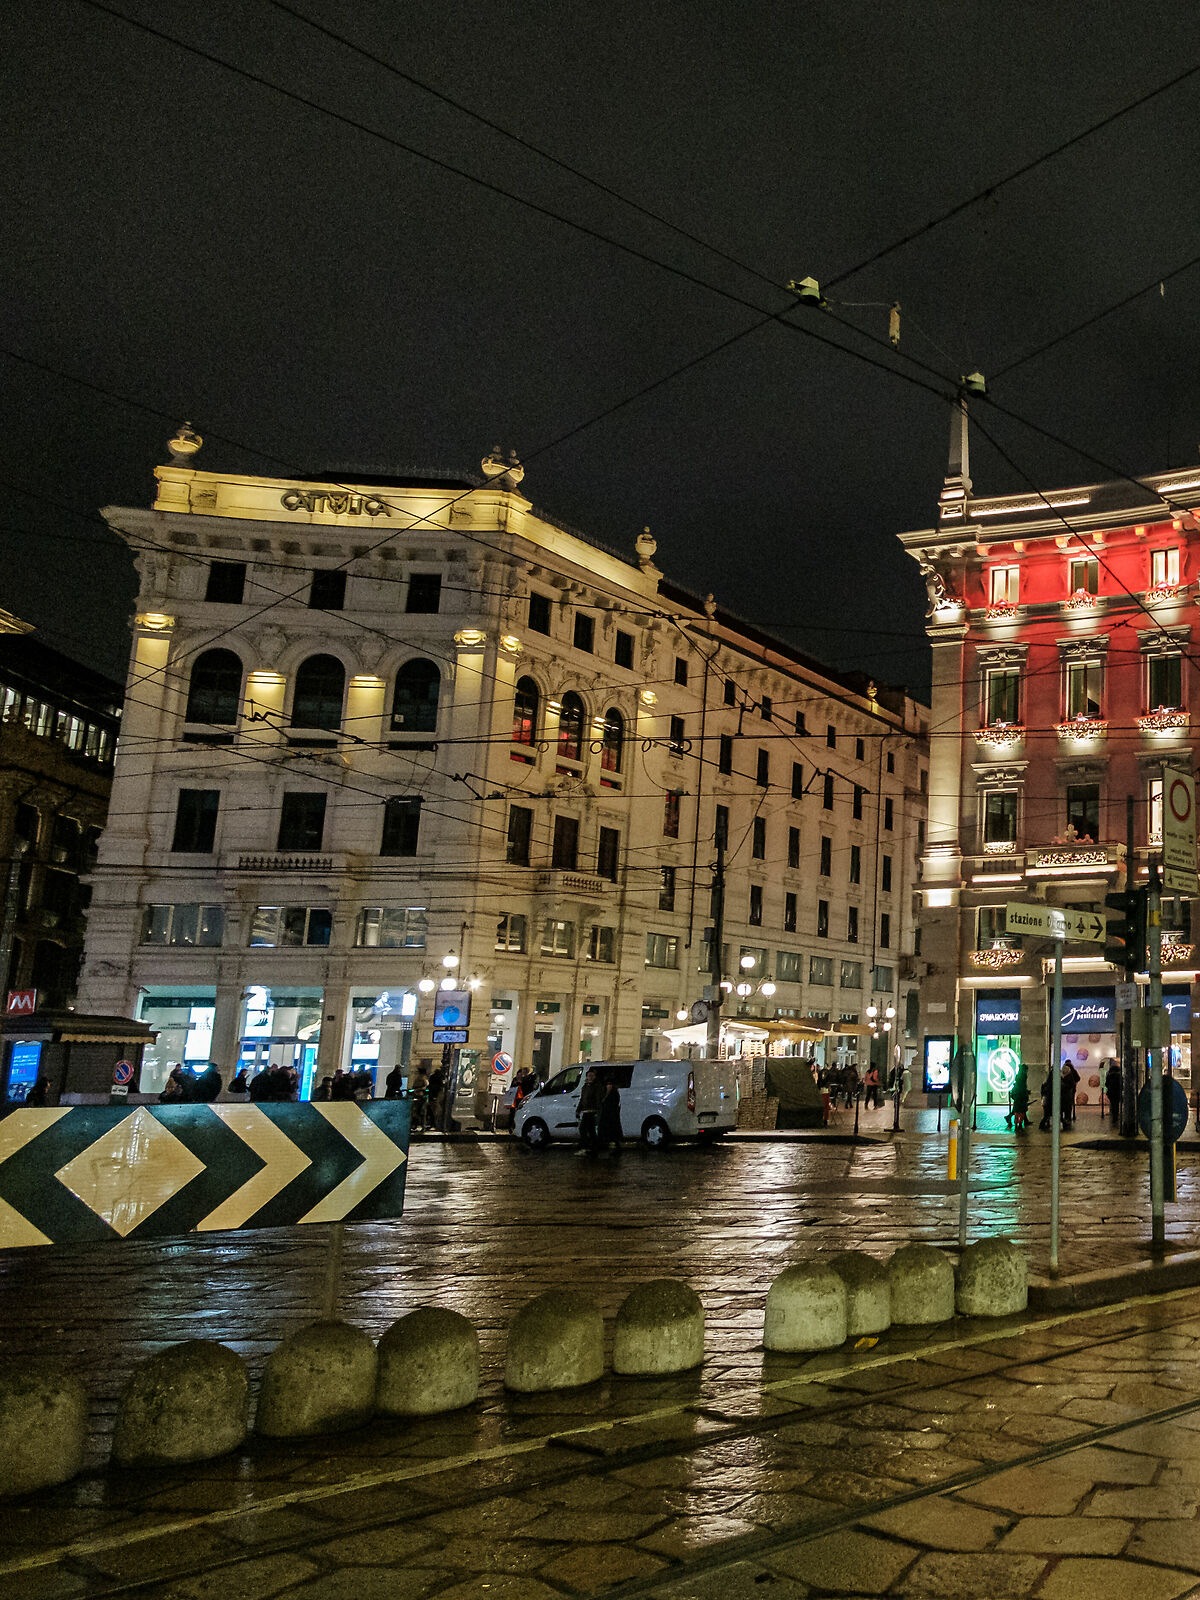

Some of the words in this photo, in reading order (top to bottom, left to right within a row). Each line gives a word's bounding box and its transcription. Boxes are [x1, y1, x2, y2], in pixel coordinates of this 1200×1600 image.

[281, 489, 391, 517] CATTOLICA
[1010, 912, 1042, 927] stazione
[1047, 916, 1071, 930] Domo
[980, 1012, 1019, 1021] SWAROVSKI
[1060, 1004, 1109, 1026] gioia
